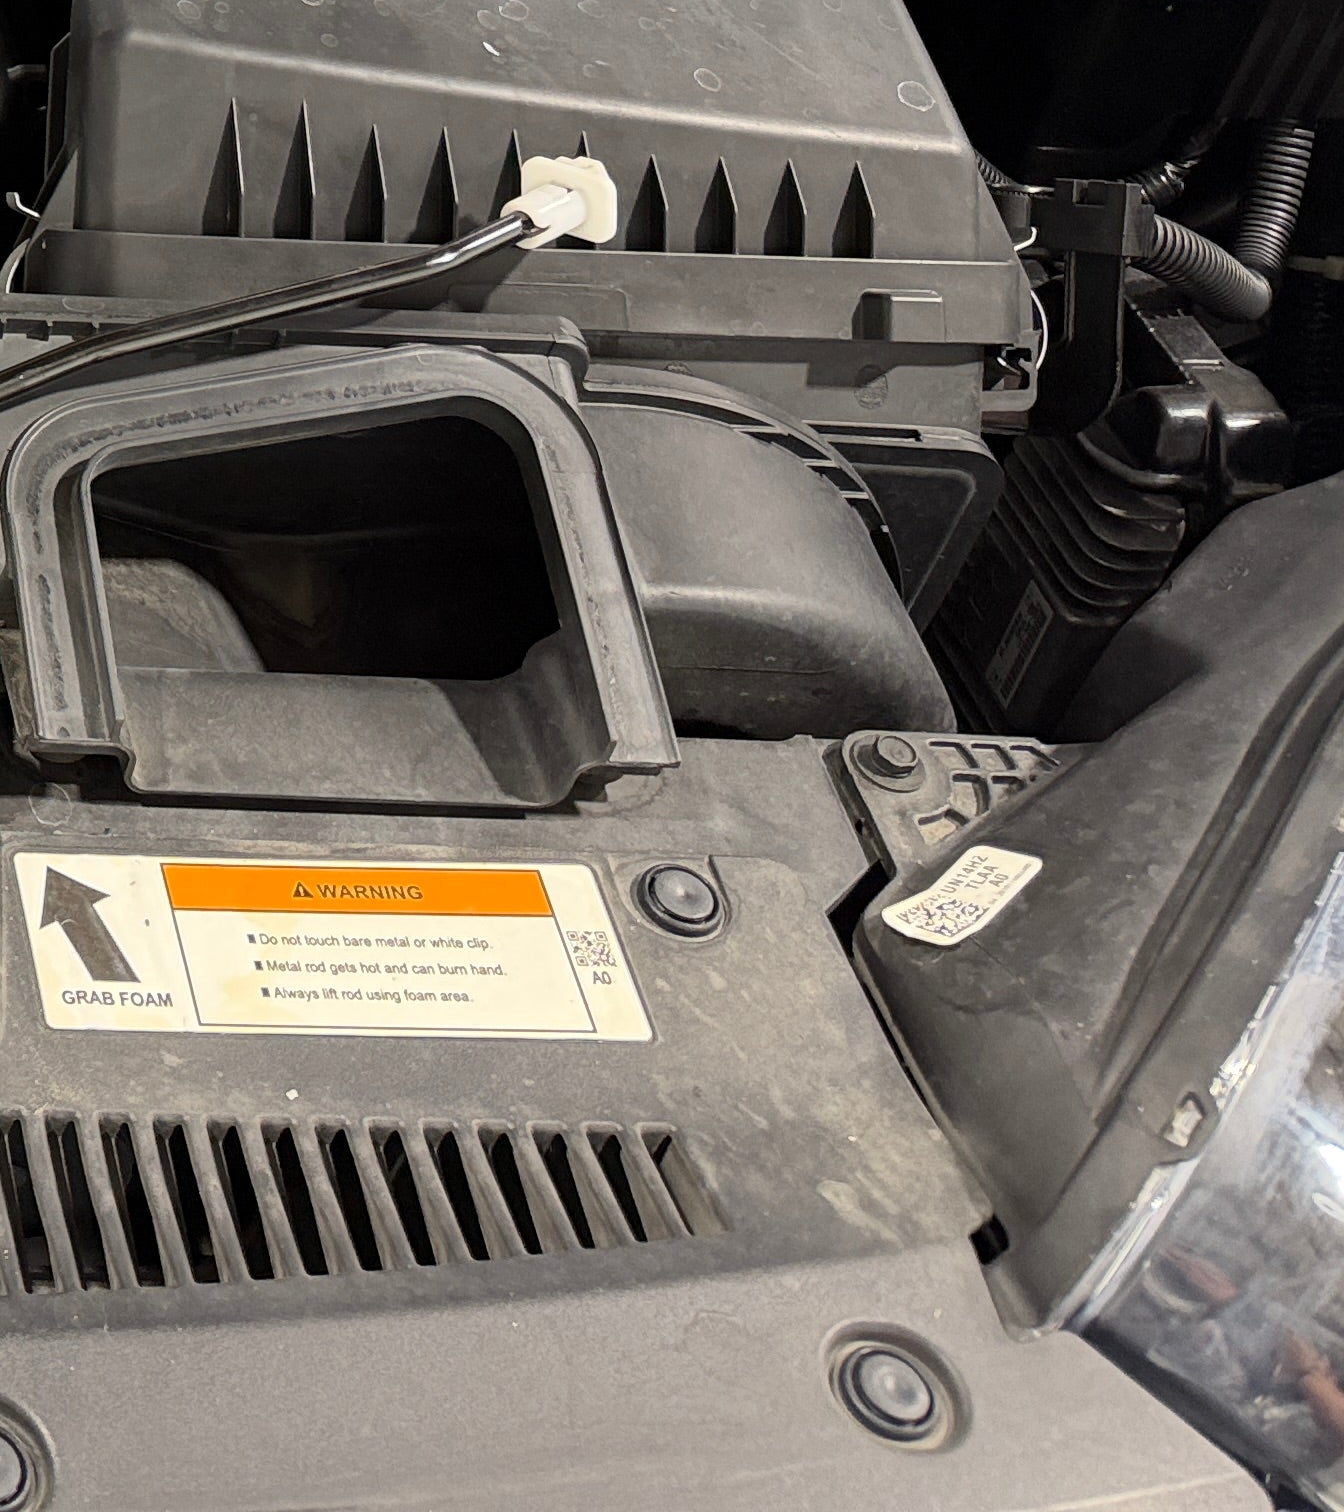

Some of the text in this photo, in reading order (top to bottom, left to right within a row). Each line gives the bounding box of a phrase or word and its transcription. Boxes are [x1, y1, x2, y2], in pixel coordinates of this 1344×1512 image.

[964, 864, 999, 891] TLAA
[317, 883, 424, 900] WARNING
[259, 933, 494, 951] Do not touch bare metal or white clip.
[266, 960, 508, 976] Metal rod gets hot and can burn hand.
[62, 990, 173, 1007] GRAB FOAM
[274, 988, 474, 1004] Always lift rod using foam area.
